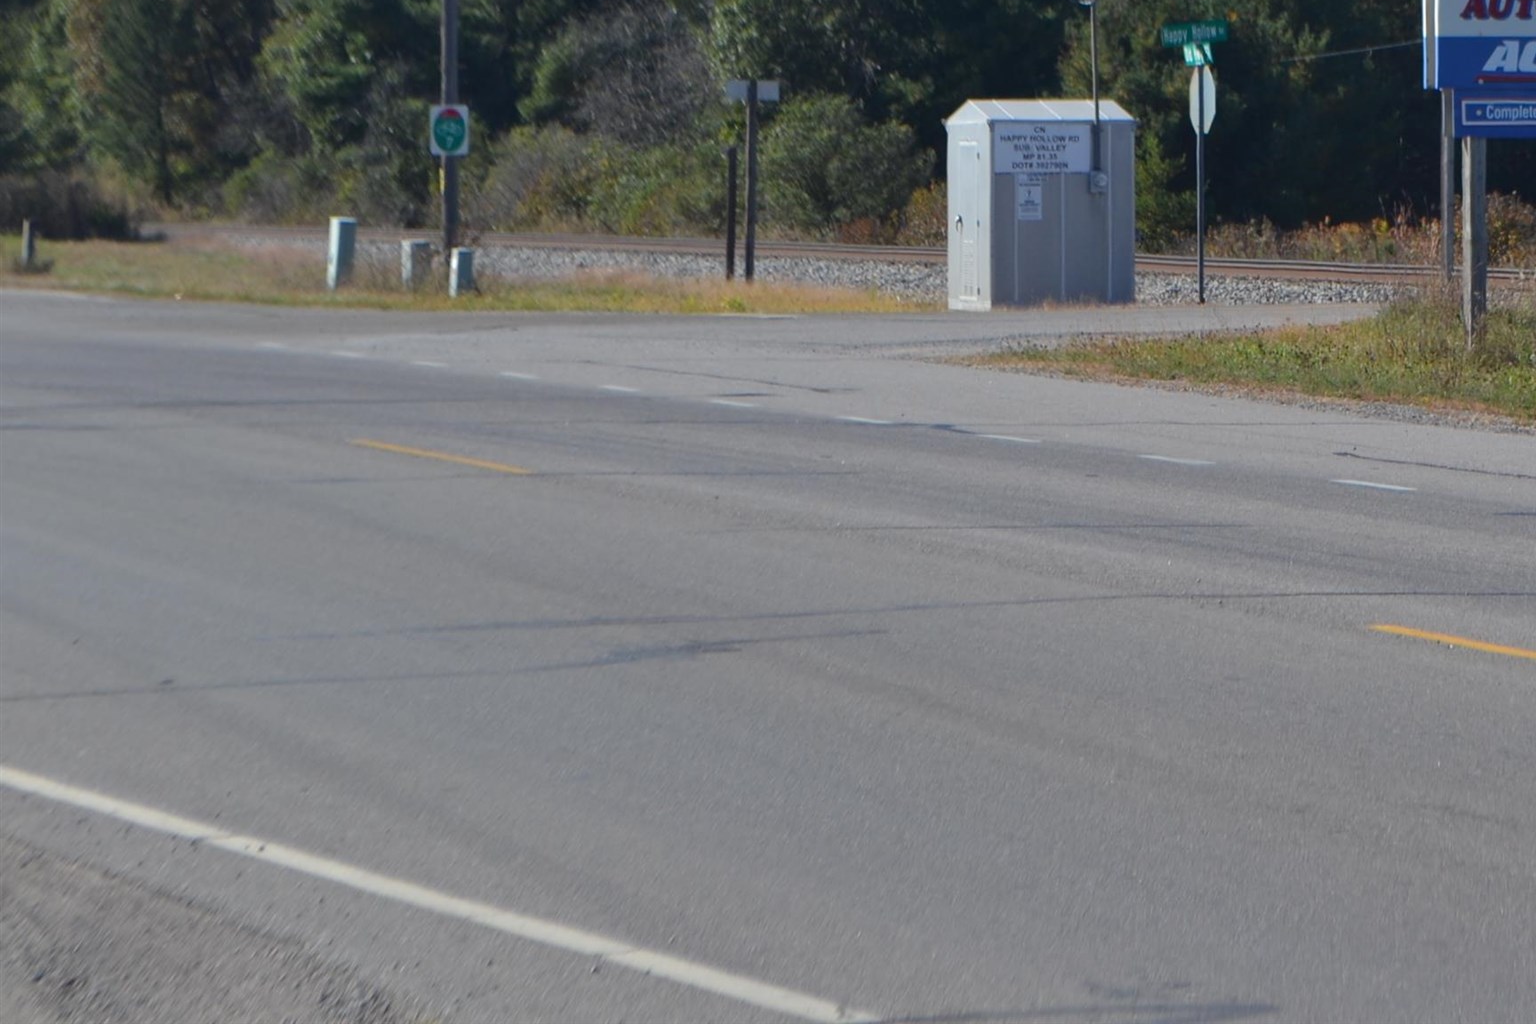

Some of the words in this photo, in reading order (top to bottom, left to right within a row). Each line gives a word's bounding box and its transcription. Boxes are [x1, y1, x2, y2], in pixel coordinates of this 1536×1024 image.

[1033, 126, 1046, 134] CN
[1029, 135, 1066, 143] HOLLOW
[1068, 135, 1080, 143] RD
[1035, 144, 1067, 152] VALLEY
